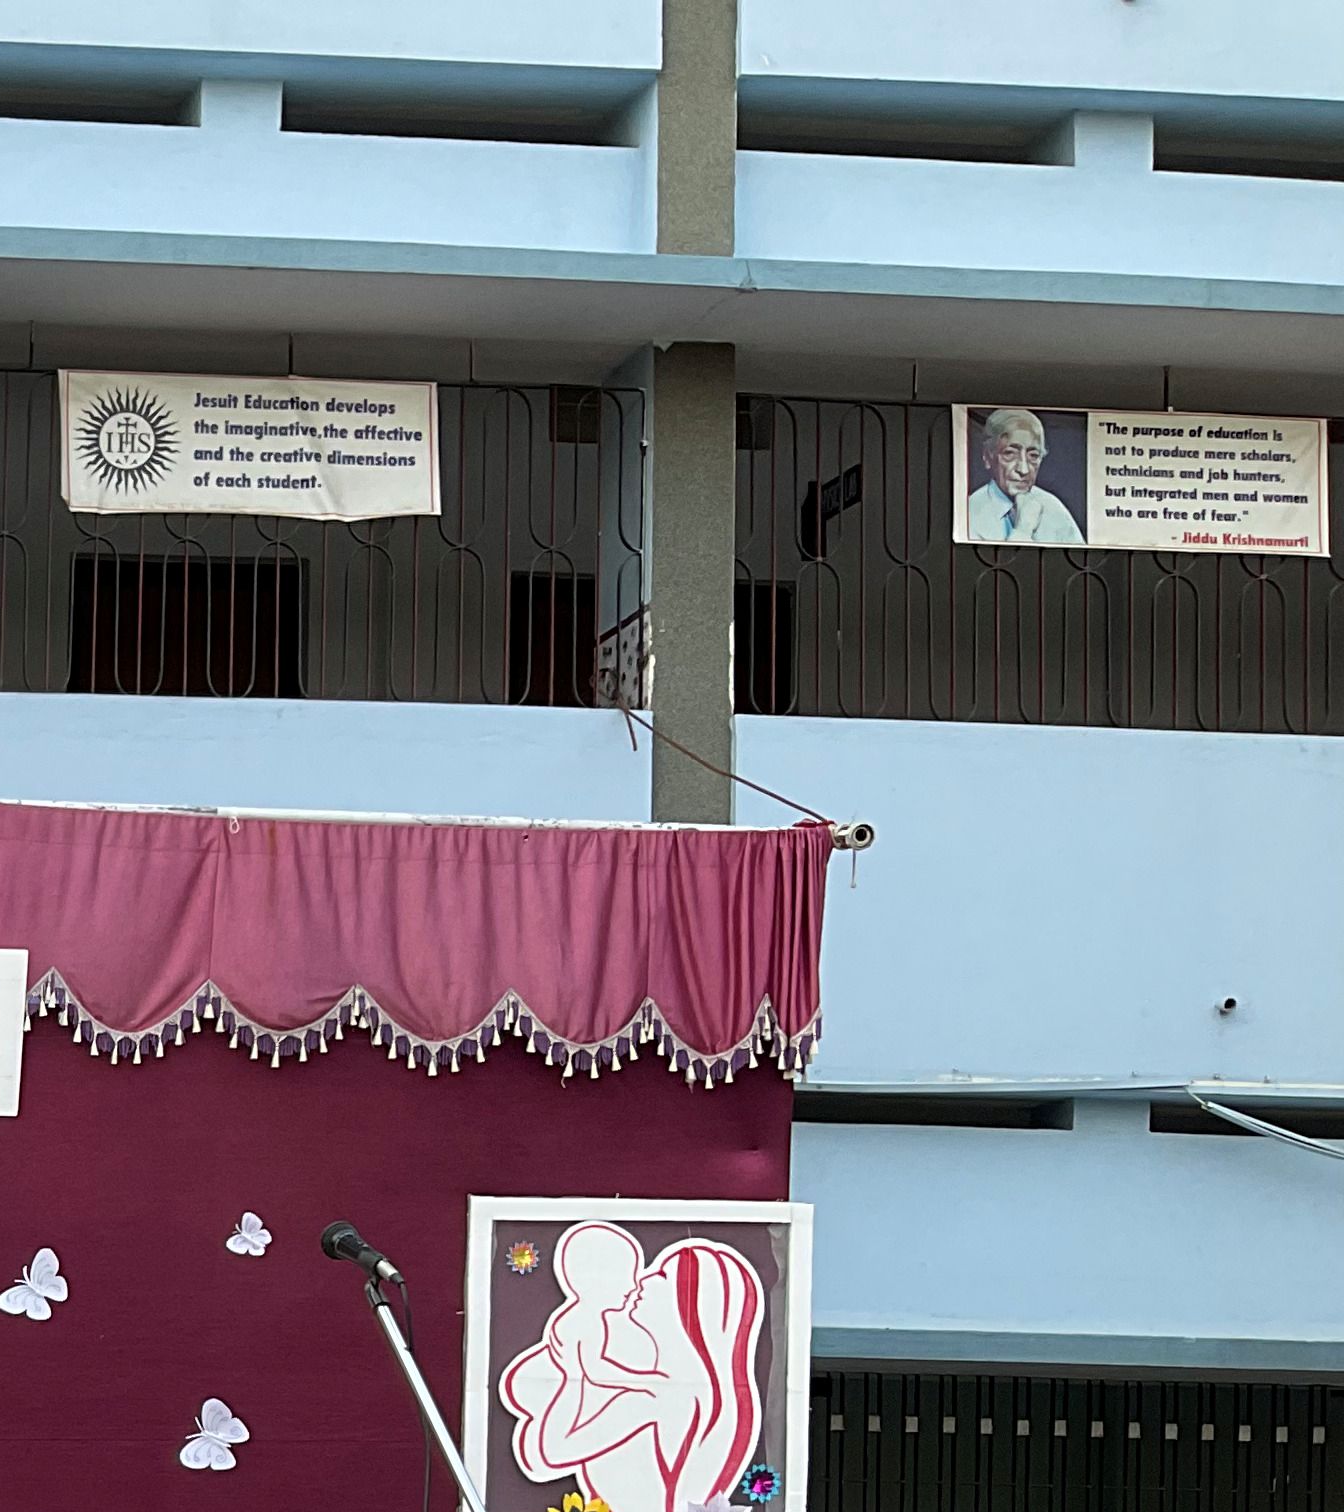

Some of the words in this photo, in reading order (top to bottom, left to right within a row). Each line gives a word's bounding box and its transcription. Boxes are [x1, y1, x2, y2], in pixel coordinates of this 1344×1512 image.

[194, 393, 239, 410] Jesuit
[244, 395, 319, 412] Education
[325, 398, 395, 417] develops
[194, 420, 219, 435] the
[354, 425, 423, 441] affective
[1132, 425, 1184, 440] purpose
[1188, 426, 1203, 438] of
[1207, 426, 1268, 441] education
[1273, 429, 1283, 441] is
[194, 446, 224, 461] and
[229, 447, 254, 462] the
[260, 448, 322, 463] creative
[327, 450, 416, 466] dimensions
[1104, 445, 1127, 456] not
[1131, 446, 1144, 457] to
[1148, 447, 1200, 459] produce
[1204, 450, 1236, 460] mere
[1240, 449, 1296, 463] scholars,
[193, 472, 211, 487] of
[216, 473, 251, 488] each
[257, 474, 322, 489] student.
[1105, 465, 1174, 479] technicians
[1180, 467, 1203, 479] and
[1207, 467, 1228, 483] job
[1233, 469, 1286, 483] hunters,
[1104, 485, 1126, 497] but
[1131, 486, 1197, 501] integrated
[1202, 491, 1229, 501] men
[1234, 490, 1258, 502] and
[1262, 494, 1308, 504] women
[1105, 506, 1132, 518] who
[1137, 510, 1158, 519] are
[1163, 507, 1188, 520] free
[1193, 508, 1206, 521] of
[1181, 532, 1217, 545] Jiddu
[1222, 533, 1309, 547] Krishnamurti
